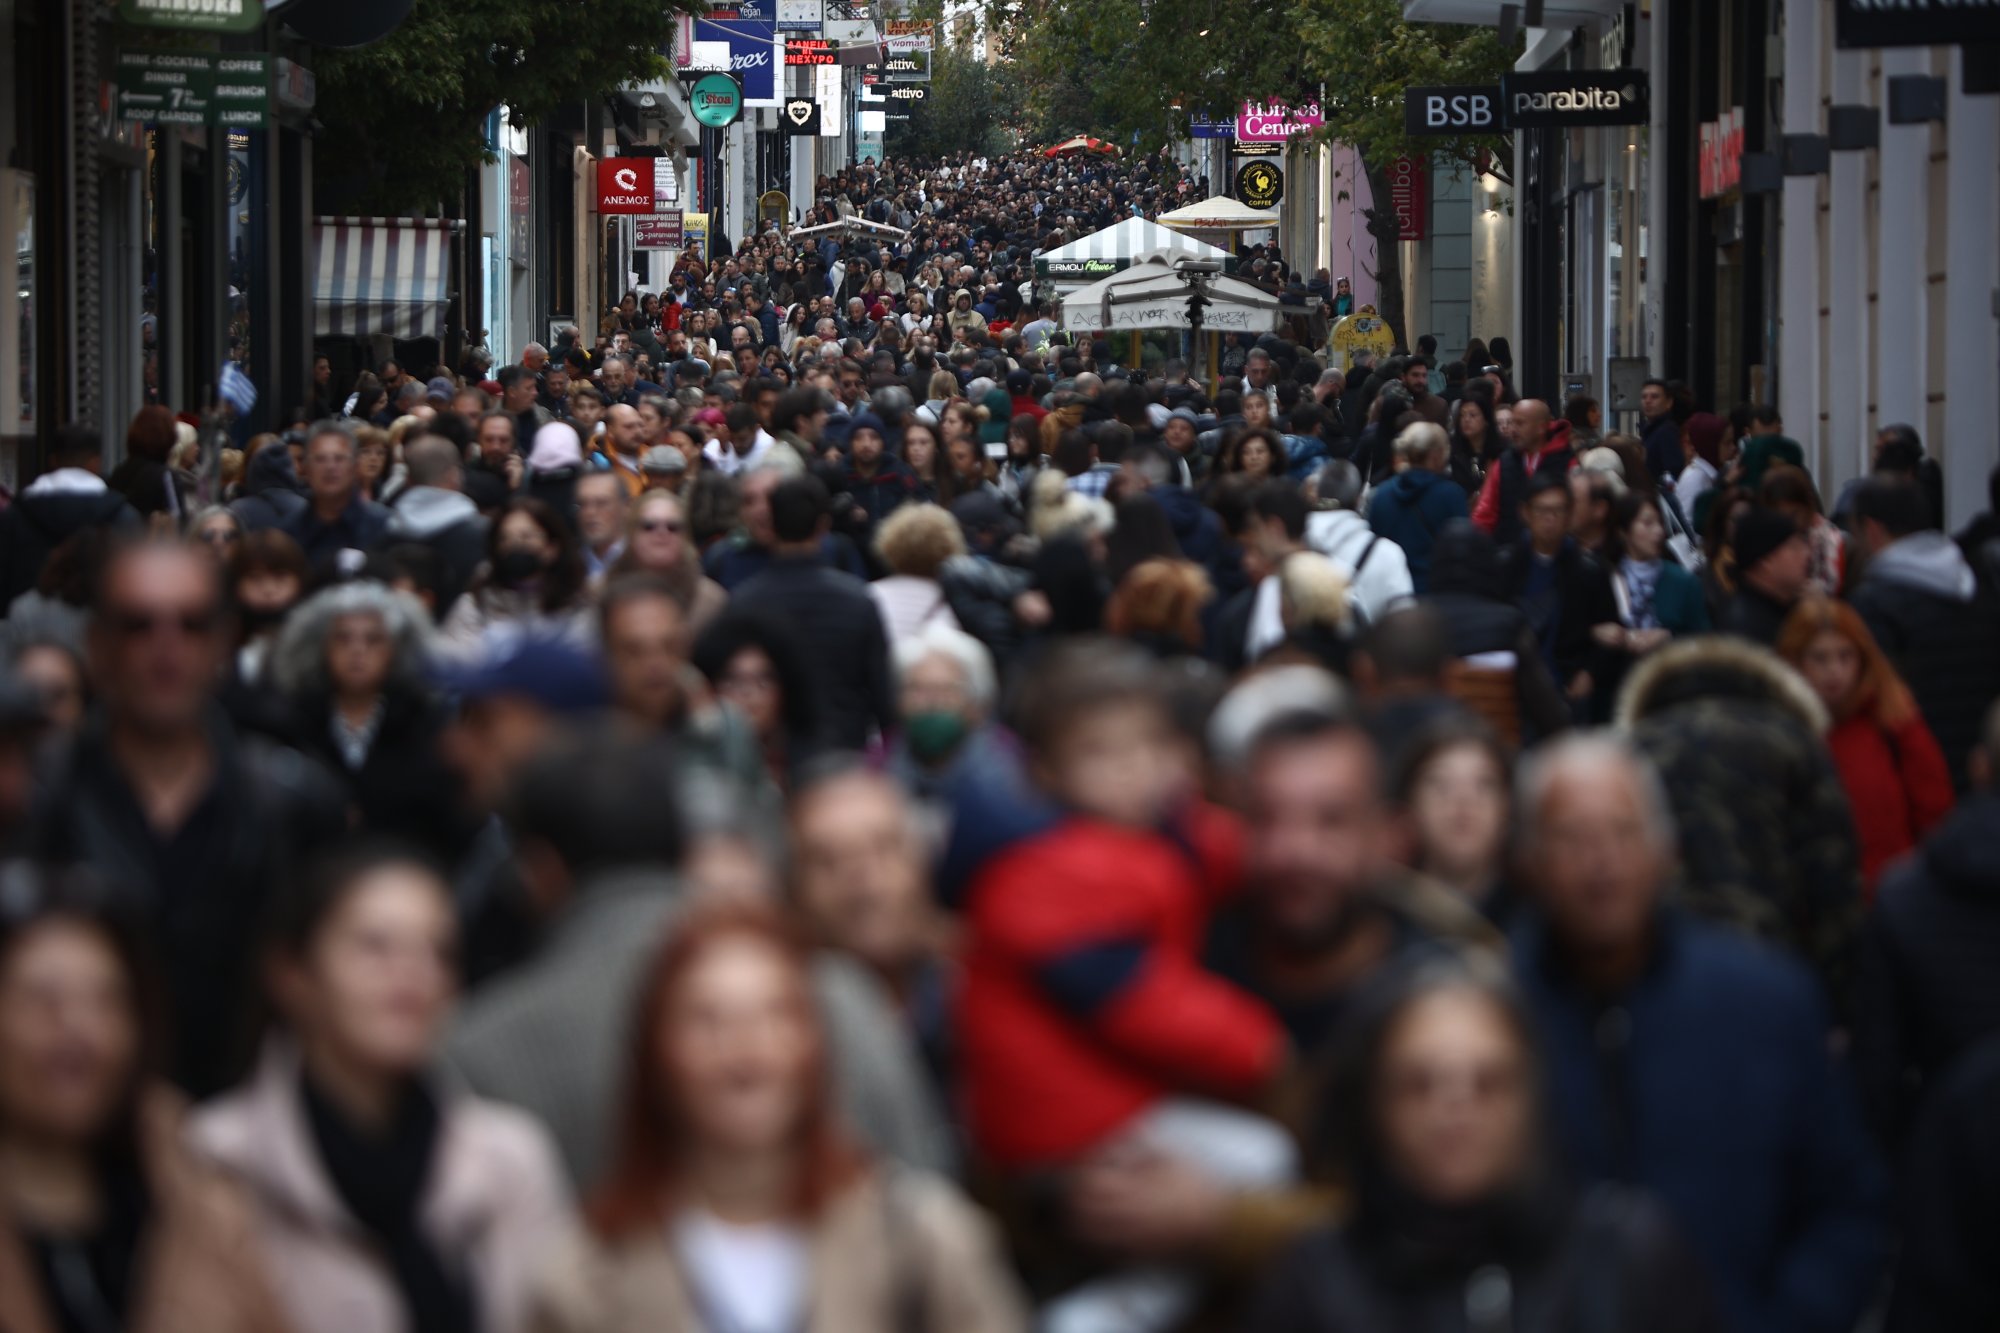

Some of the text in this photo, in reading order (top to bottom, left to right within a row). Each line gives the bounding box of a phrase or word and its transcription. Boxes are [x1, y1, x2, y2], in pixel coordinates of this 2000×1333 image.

[784, 55, 834, 64] ΕΝΕΧΥΡΟ
[218, 60, 264, 71] COFFEE
[143, 72, 188, 83] DINNER
[216, 86, 266, 98] BRUNCH
[891, 87, 924, 99] attivo
[1514, 87, 1621, 115] parabita
[1427, 95, 1493, 126] BSB
[158, 111, 204, 122] GARDEN
[220, 111, 262, 122] LUNCH
[1245, 117, 1311, 136] Center
[603, 195, 650, 205] ΑΝΕΜΟΣ
[1048, 260, 1117, 276] ERMOU Flower
